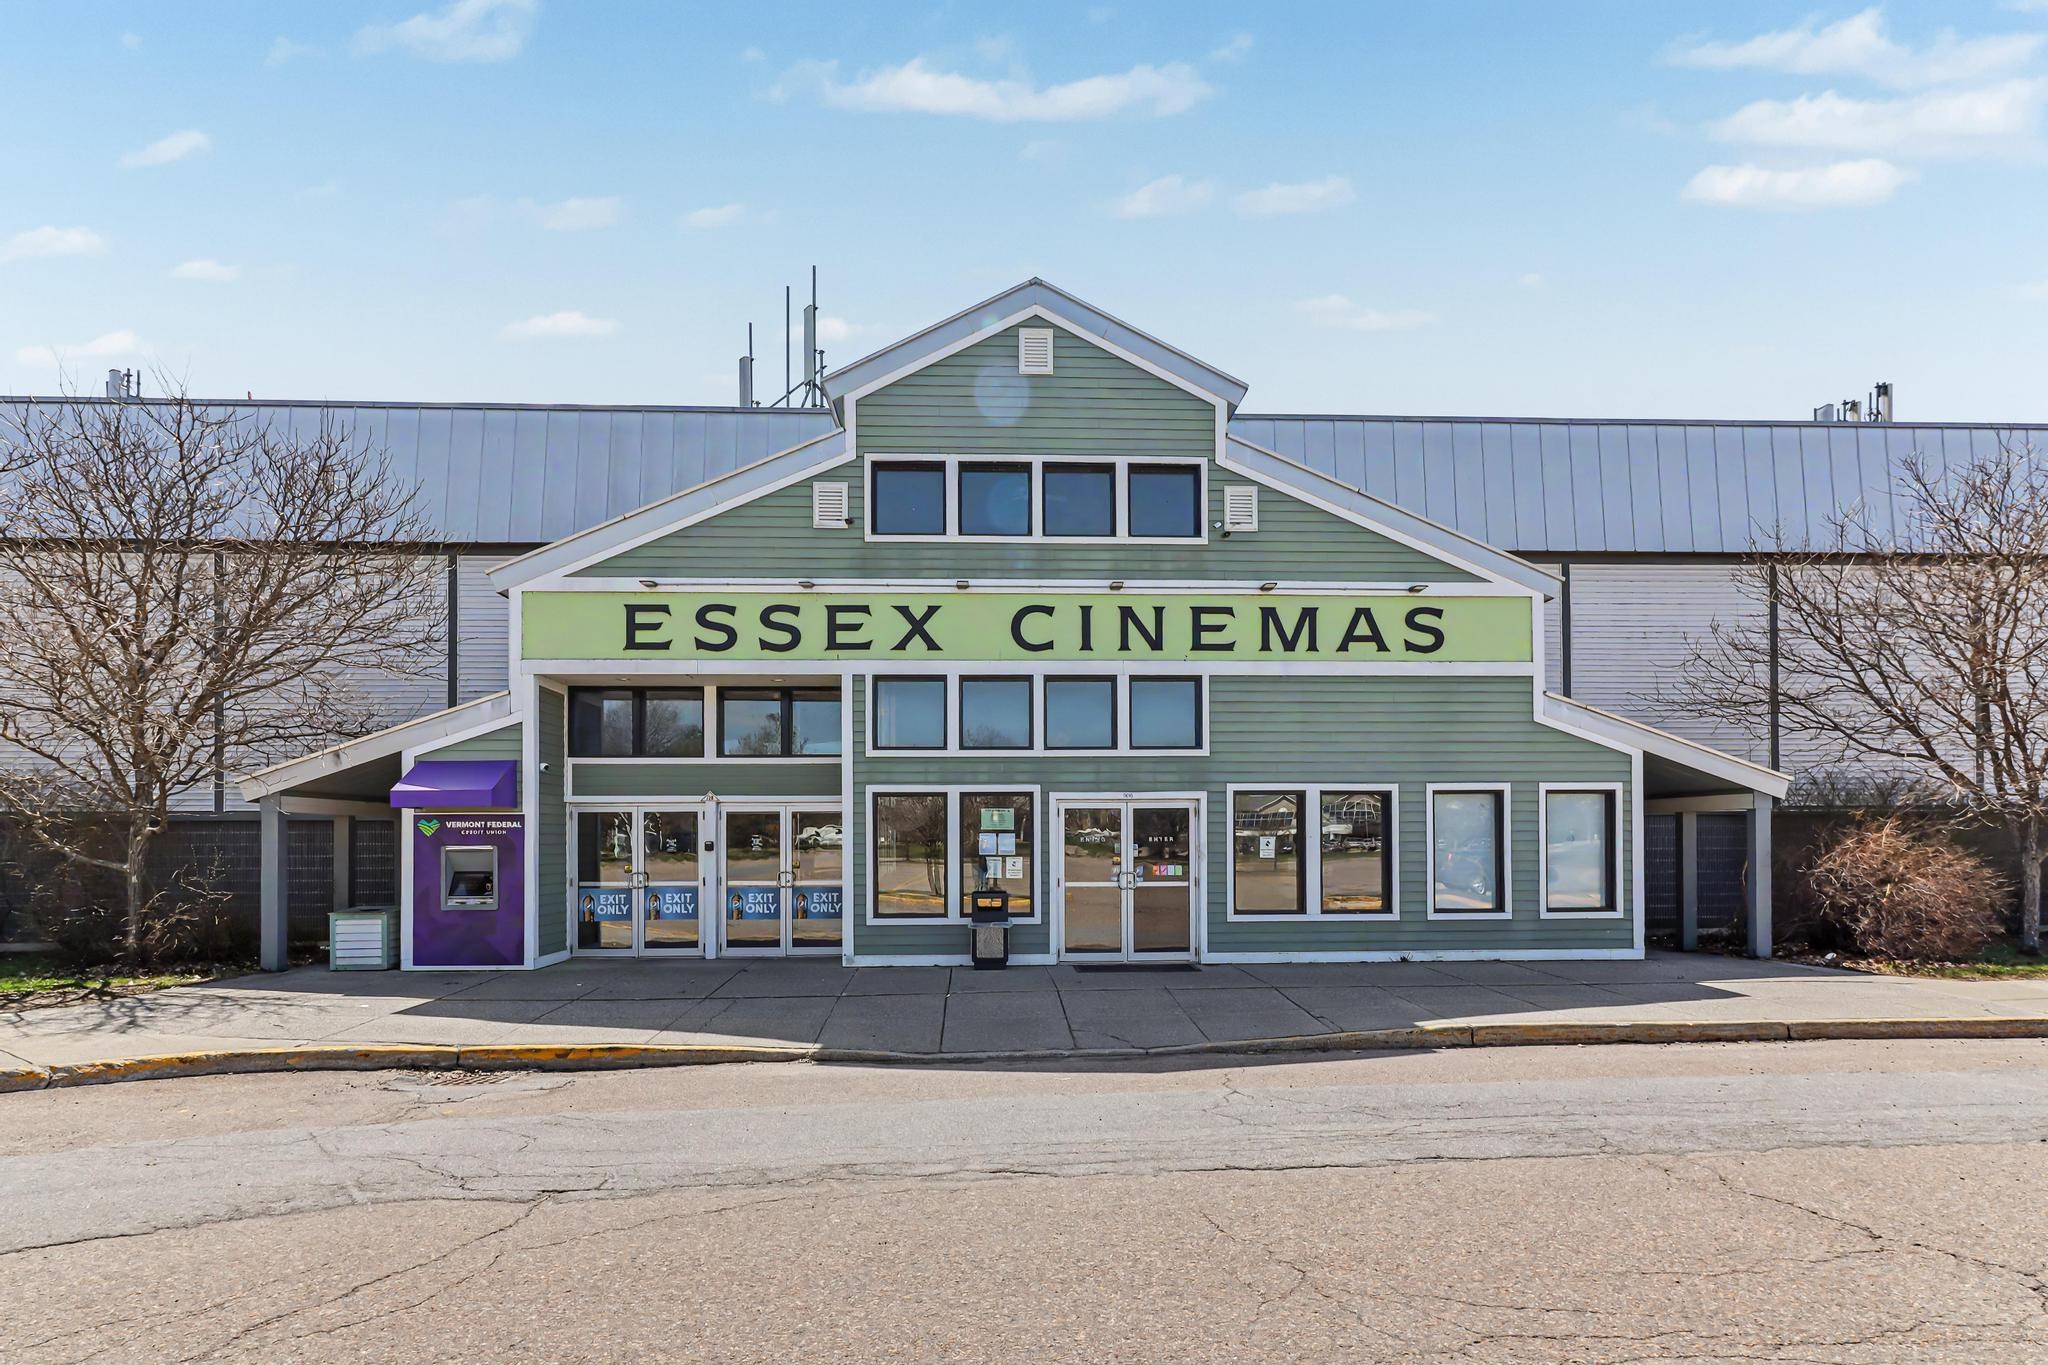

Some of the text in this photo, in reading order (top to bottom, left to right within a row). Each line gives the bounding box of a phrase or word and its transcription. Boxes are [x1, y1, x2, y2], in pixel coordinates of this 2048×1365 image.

[623, 604, 1445, 654] ESSEX CINEMAS
[599, 894, 626, 905] EXIT
[665, 893, 692, 903] EXIT
[748, 893, 774, 903] EXIT
[813, 892, 839, 903] EXIT
[597, 904, 629, 915] ONLY
[663, 903, 694, 914] ONLY
[745, 903, 777, 914] ONLY
[810, 902, 842, 913] ONLY
